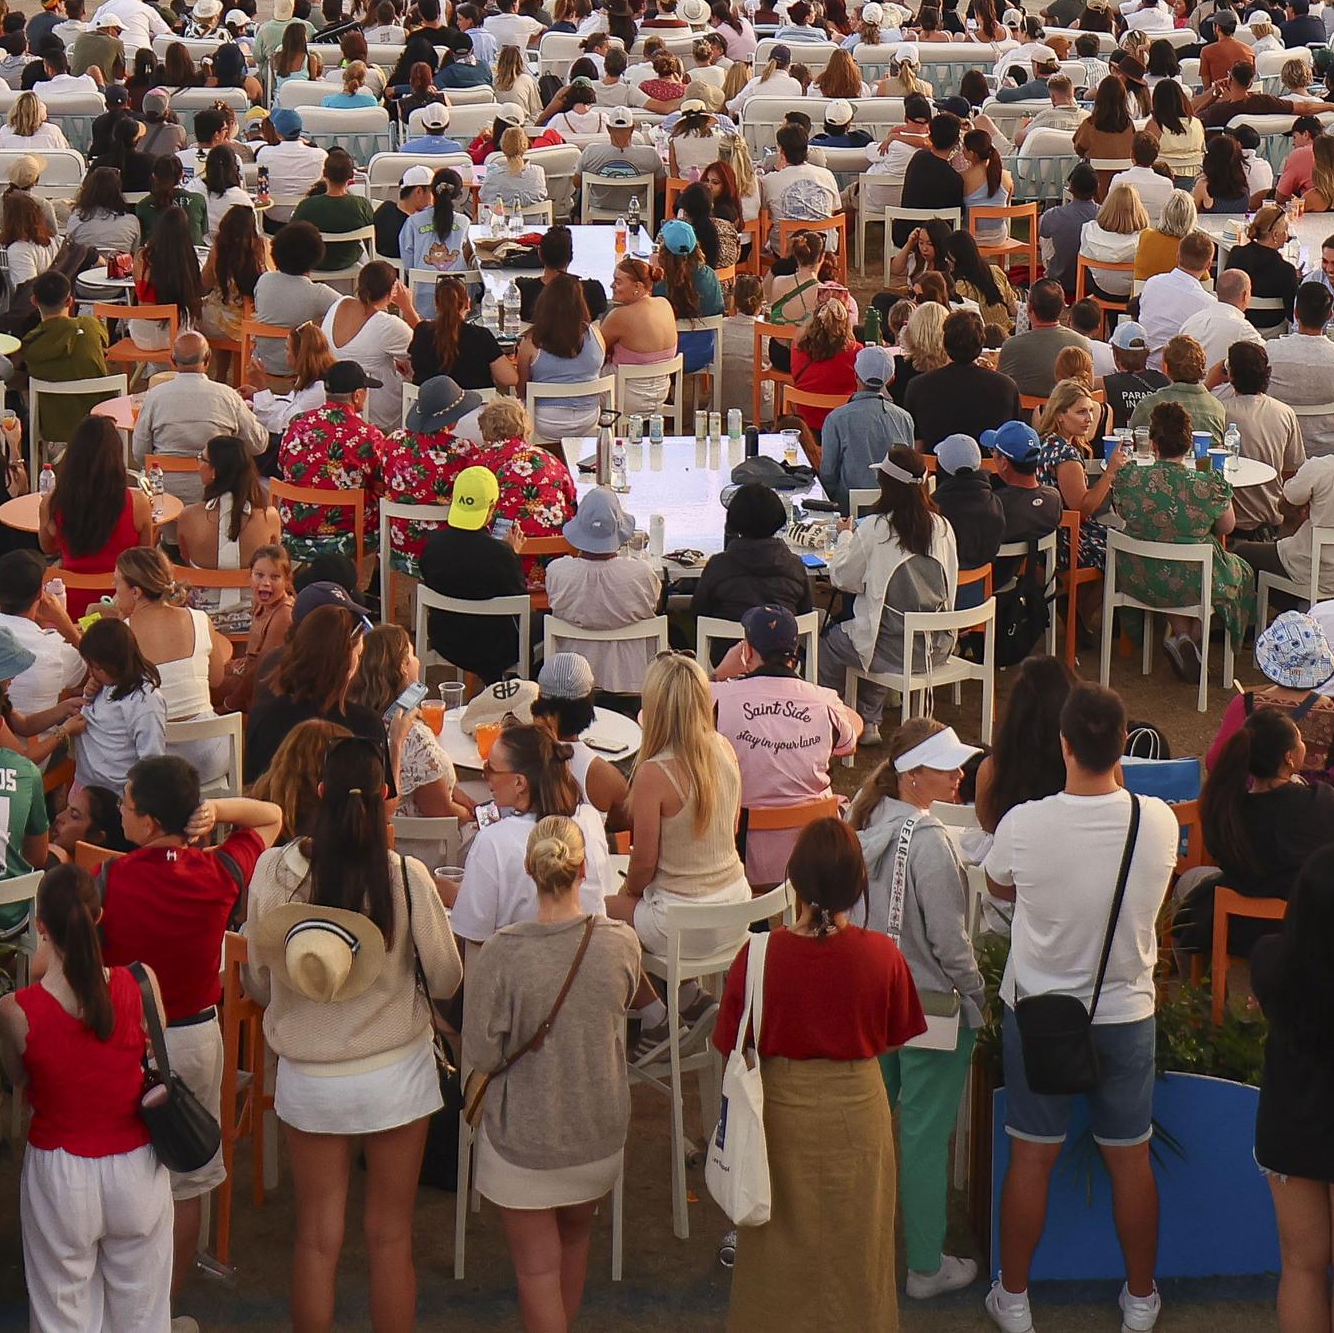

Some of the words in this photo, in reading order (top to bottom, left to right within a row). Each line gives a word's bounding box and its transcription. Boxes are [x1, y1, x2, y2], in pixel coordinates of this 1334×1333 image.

[459, 495, 474, 506] AO
[742, 700, 781, 721] Saint
[781, 700, 812, 723] Side
[736, 729, 761, 749] stay
[761, 736, 773, 749] in
[773, 739, 799, 755] your
[799, 734, 821, 748] lane
